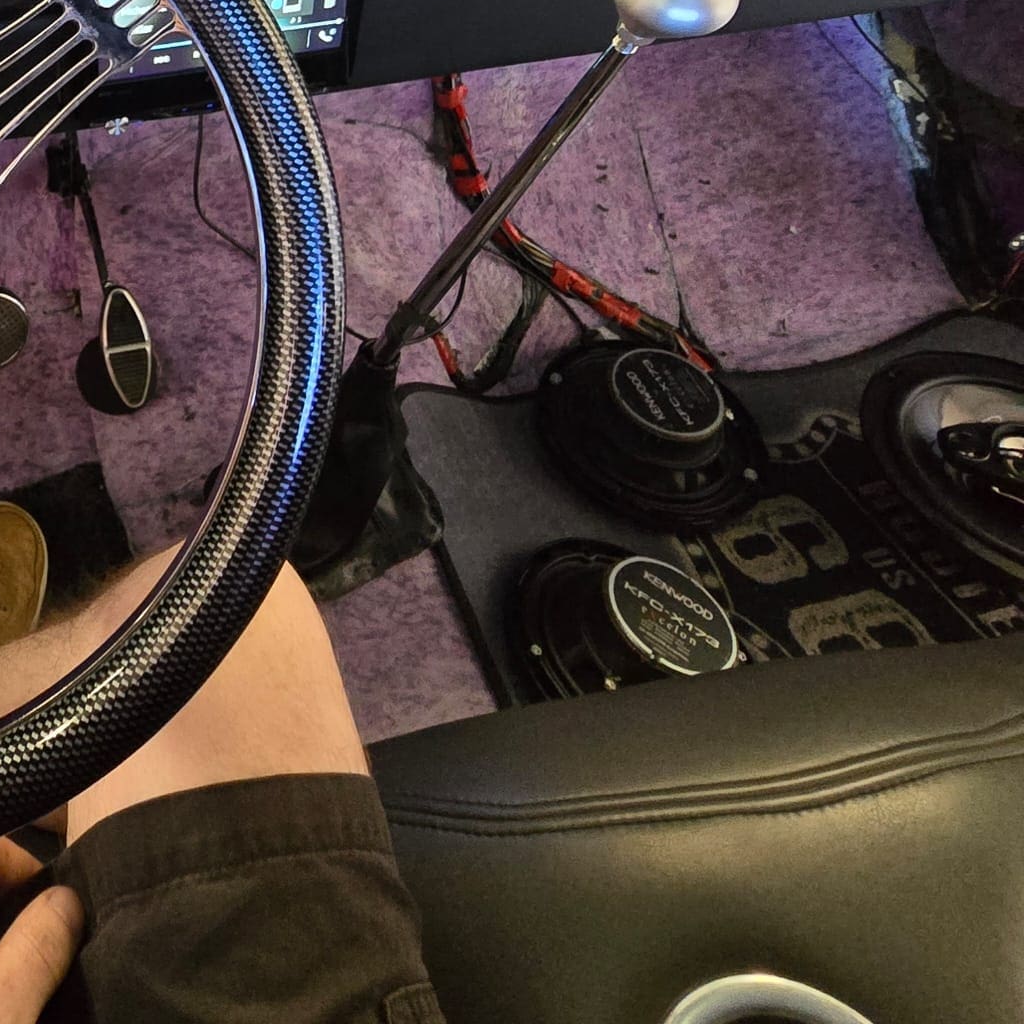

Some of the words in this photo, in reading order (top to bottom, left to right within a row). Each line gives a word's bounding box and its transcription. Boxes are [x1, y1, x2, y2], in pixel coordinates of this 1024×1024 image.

[626, 370, 666, 421] KENWOOD
[861, 546, 917, 591] US
[623, 580, 721, 650] KFC-X173
[642, 569, 715, 622] KENWOOD
